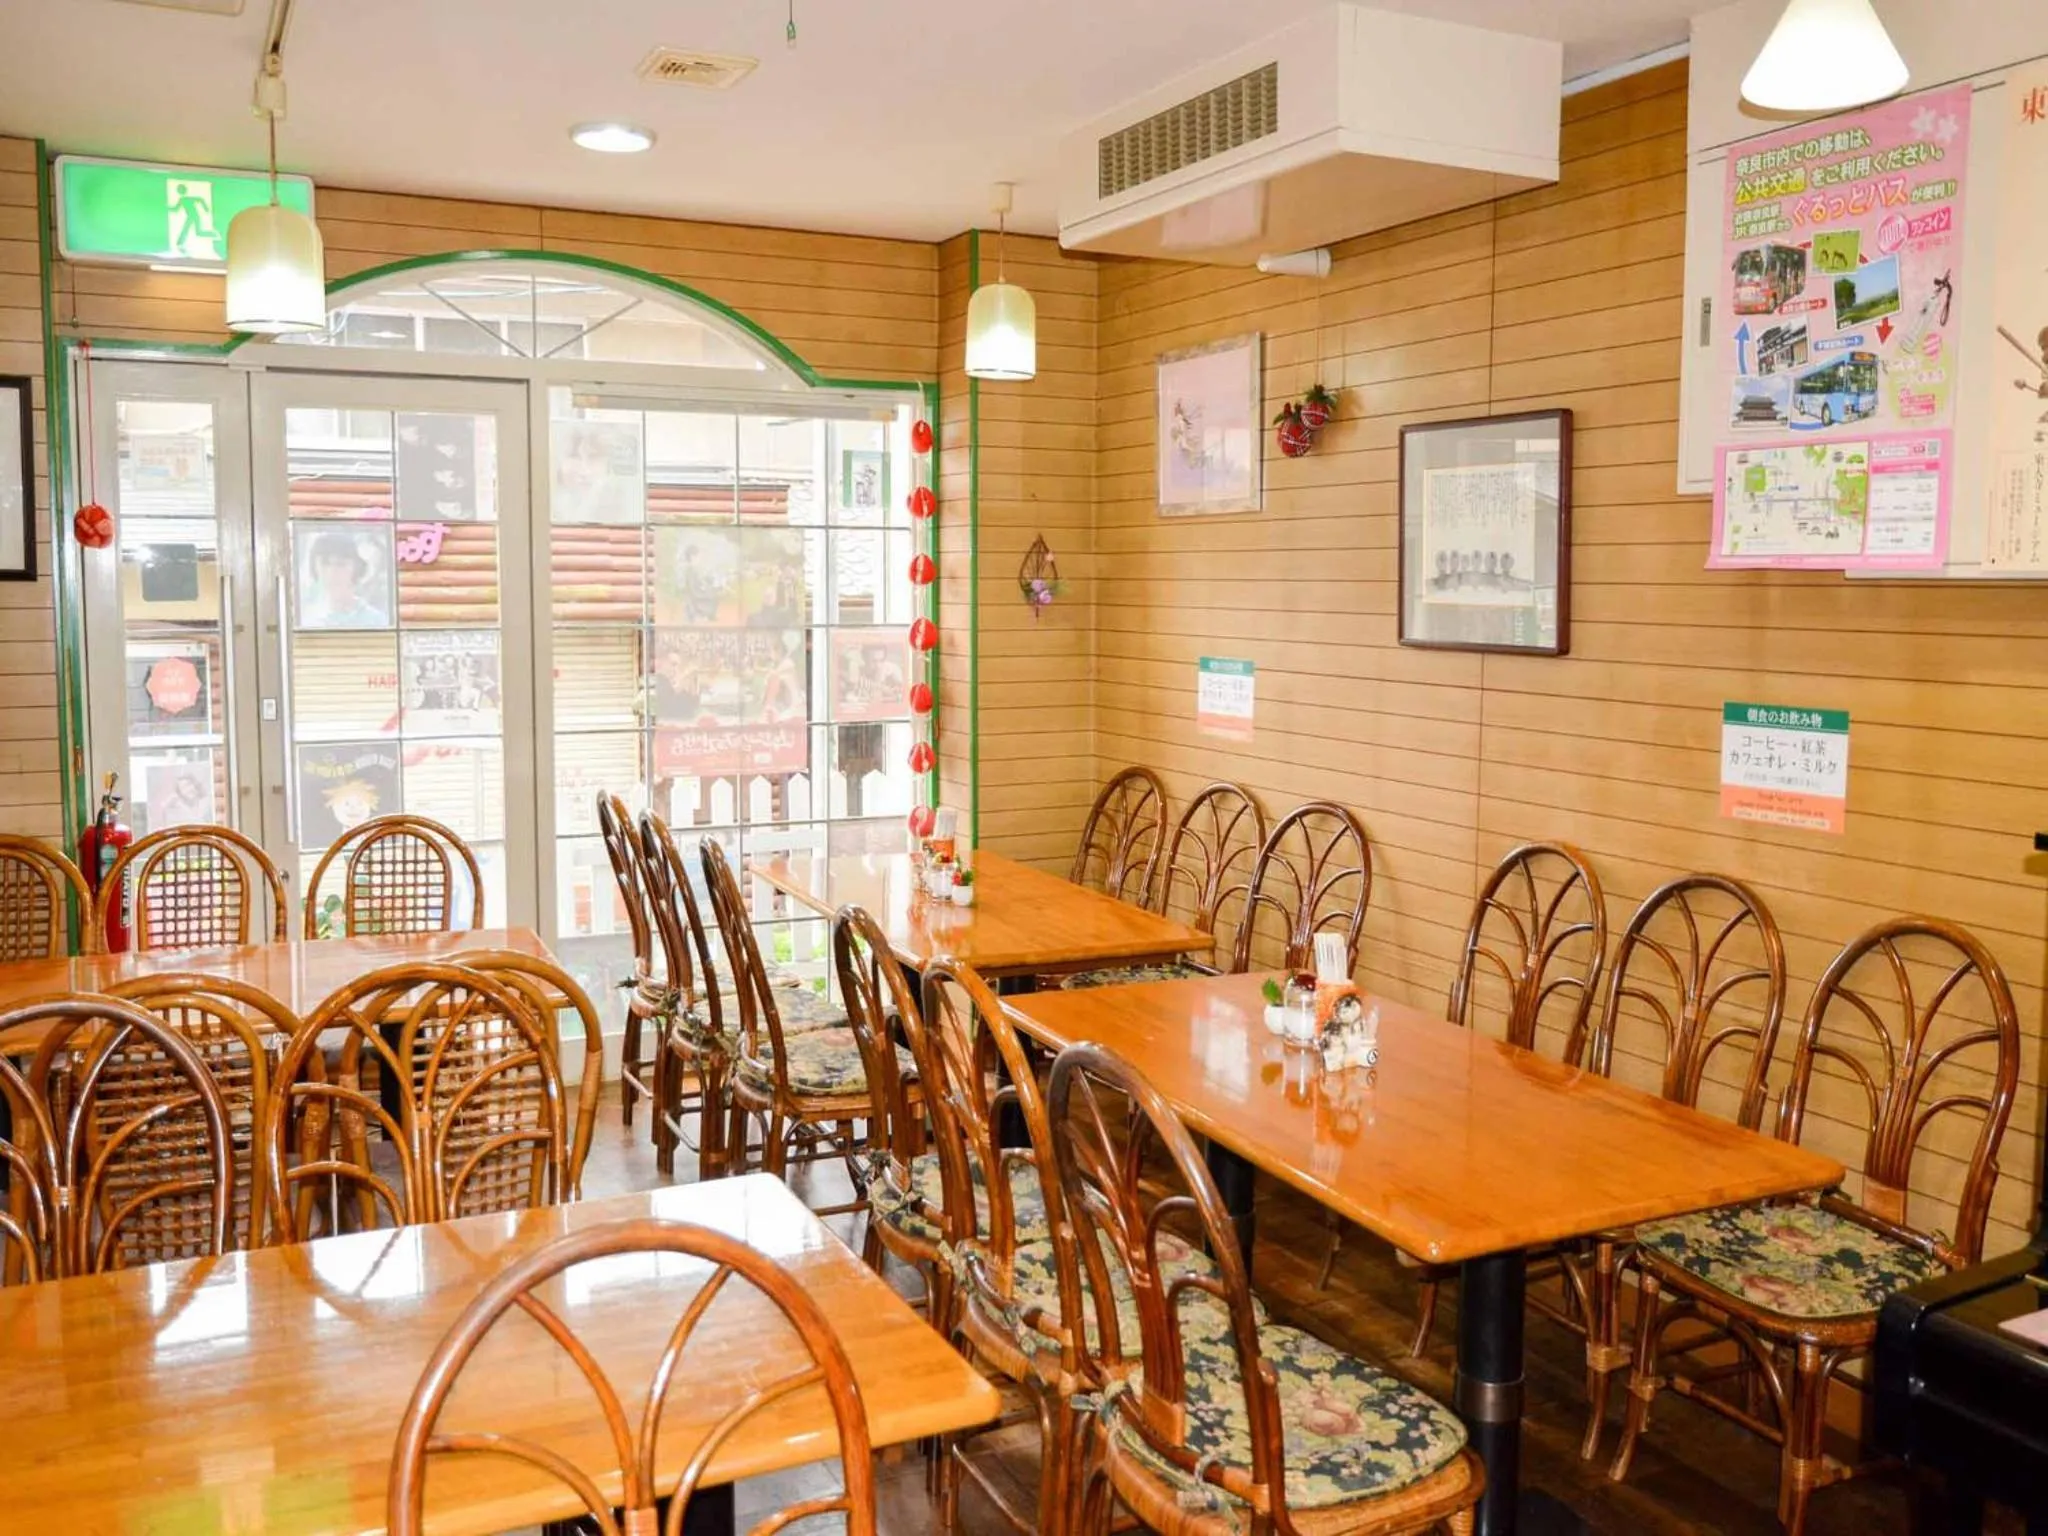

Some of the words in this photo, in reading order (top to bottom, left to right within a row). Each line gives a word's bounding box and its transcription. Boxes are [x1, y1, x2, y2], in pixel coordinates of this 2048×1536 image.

[1736, 130, 1871, 176] 奈良市内での移動は、
[1735, 167, 1806, 206] 公共交通
[1811, 144, 1945, 188] をご利用ください。
[1792, 175, 1908, 225] ぐるっとバス
[1747, 707, 1823, 728] 朝食のお飲み物
[1729, 748, 1837, 774] カフェオレ・ミルク
[1742, 735, 1826, 756] コーヒー・紅茶
